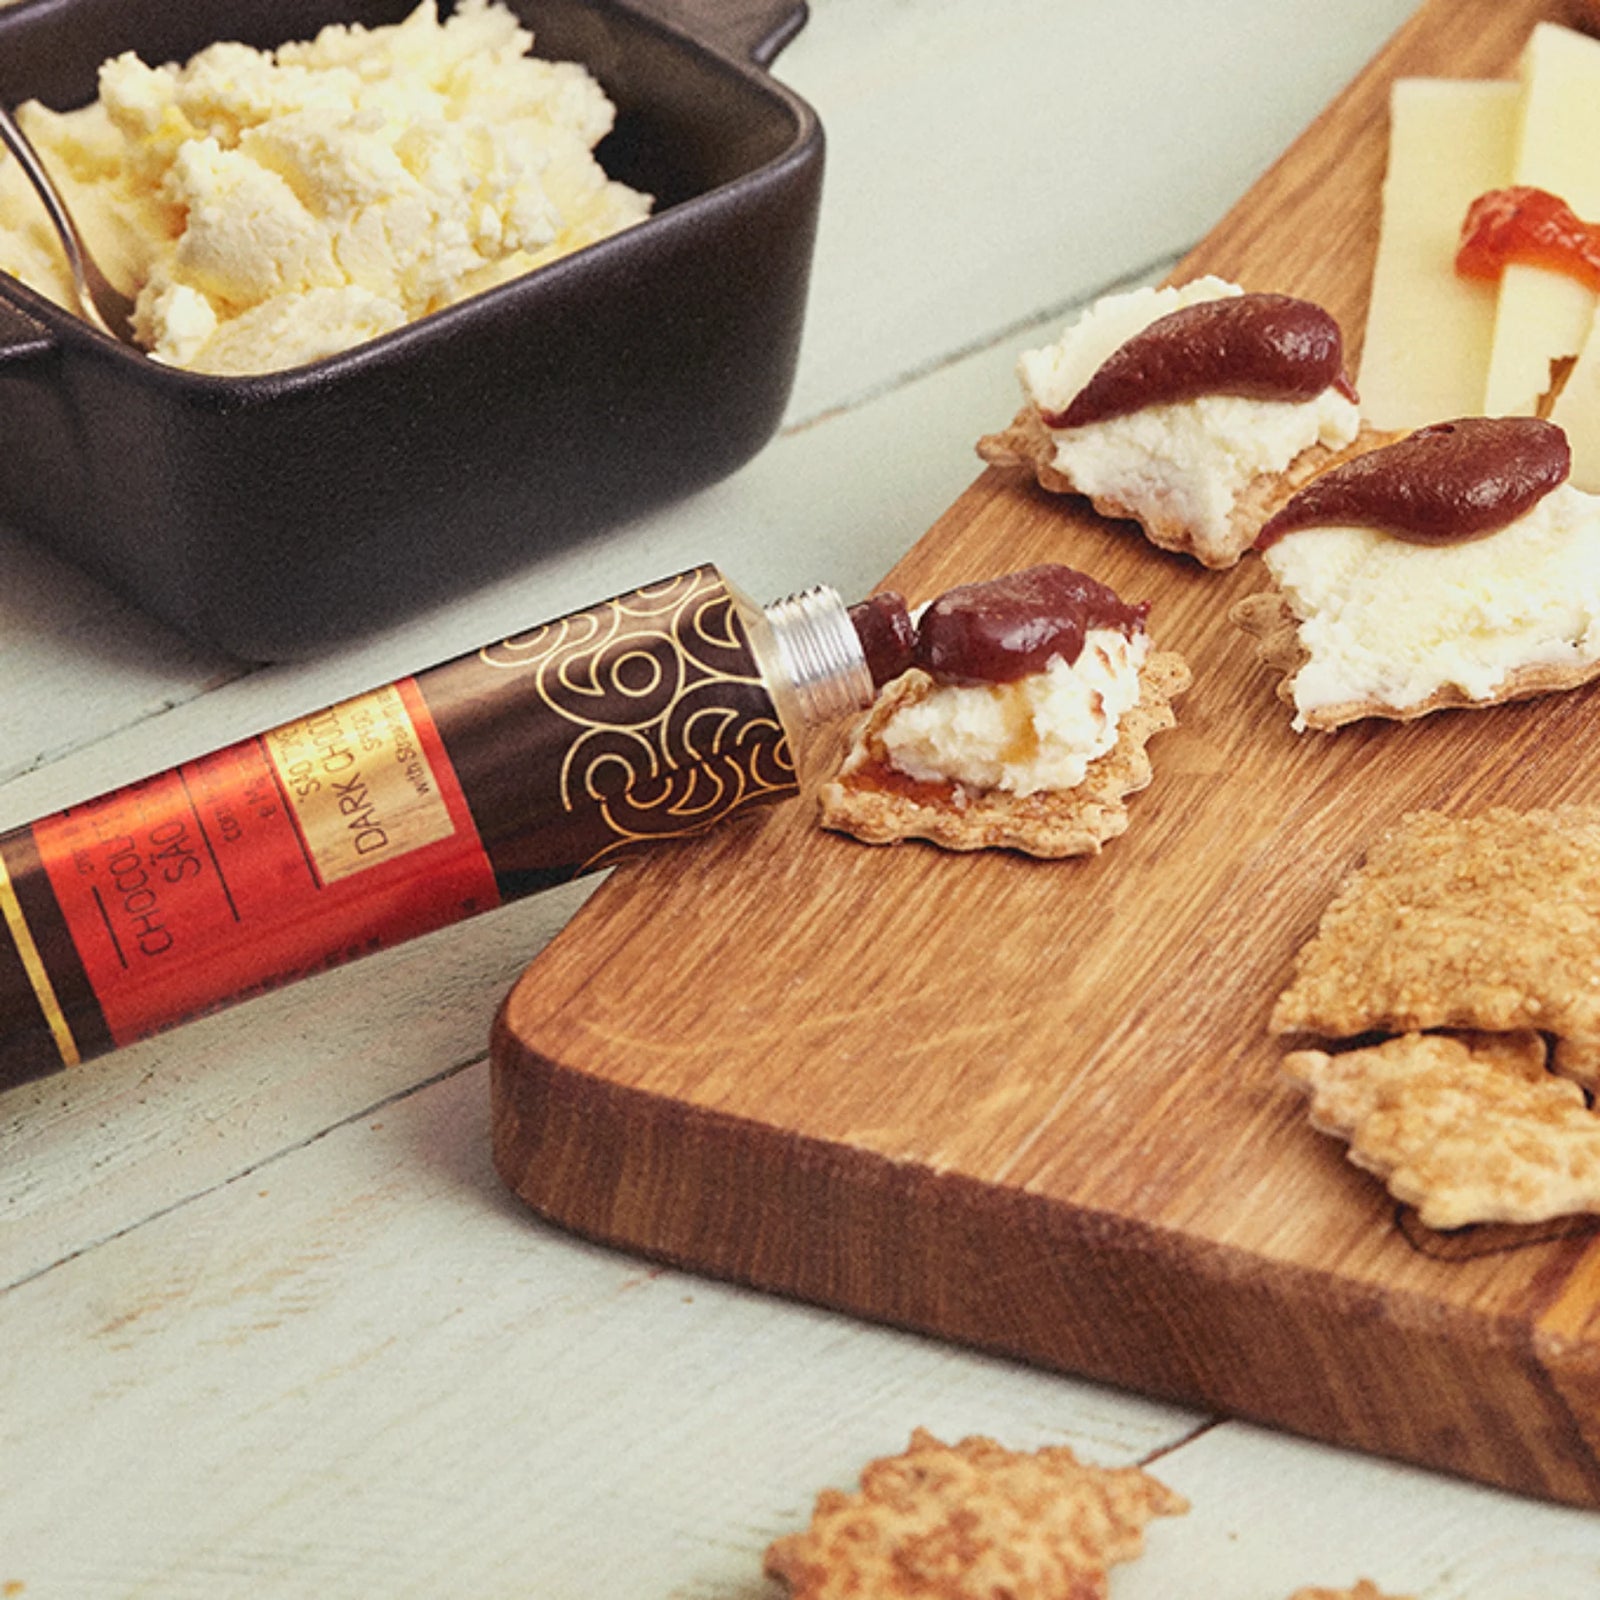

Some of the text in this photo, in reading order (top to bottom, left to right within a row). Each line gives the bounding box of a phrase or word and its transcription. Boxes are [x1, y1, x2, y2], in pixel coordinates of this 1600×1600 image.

[405, 761, 430, 797] with
[331, 772, 388, 855] DARK
[149, 821, 201, 883] SÃO
